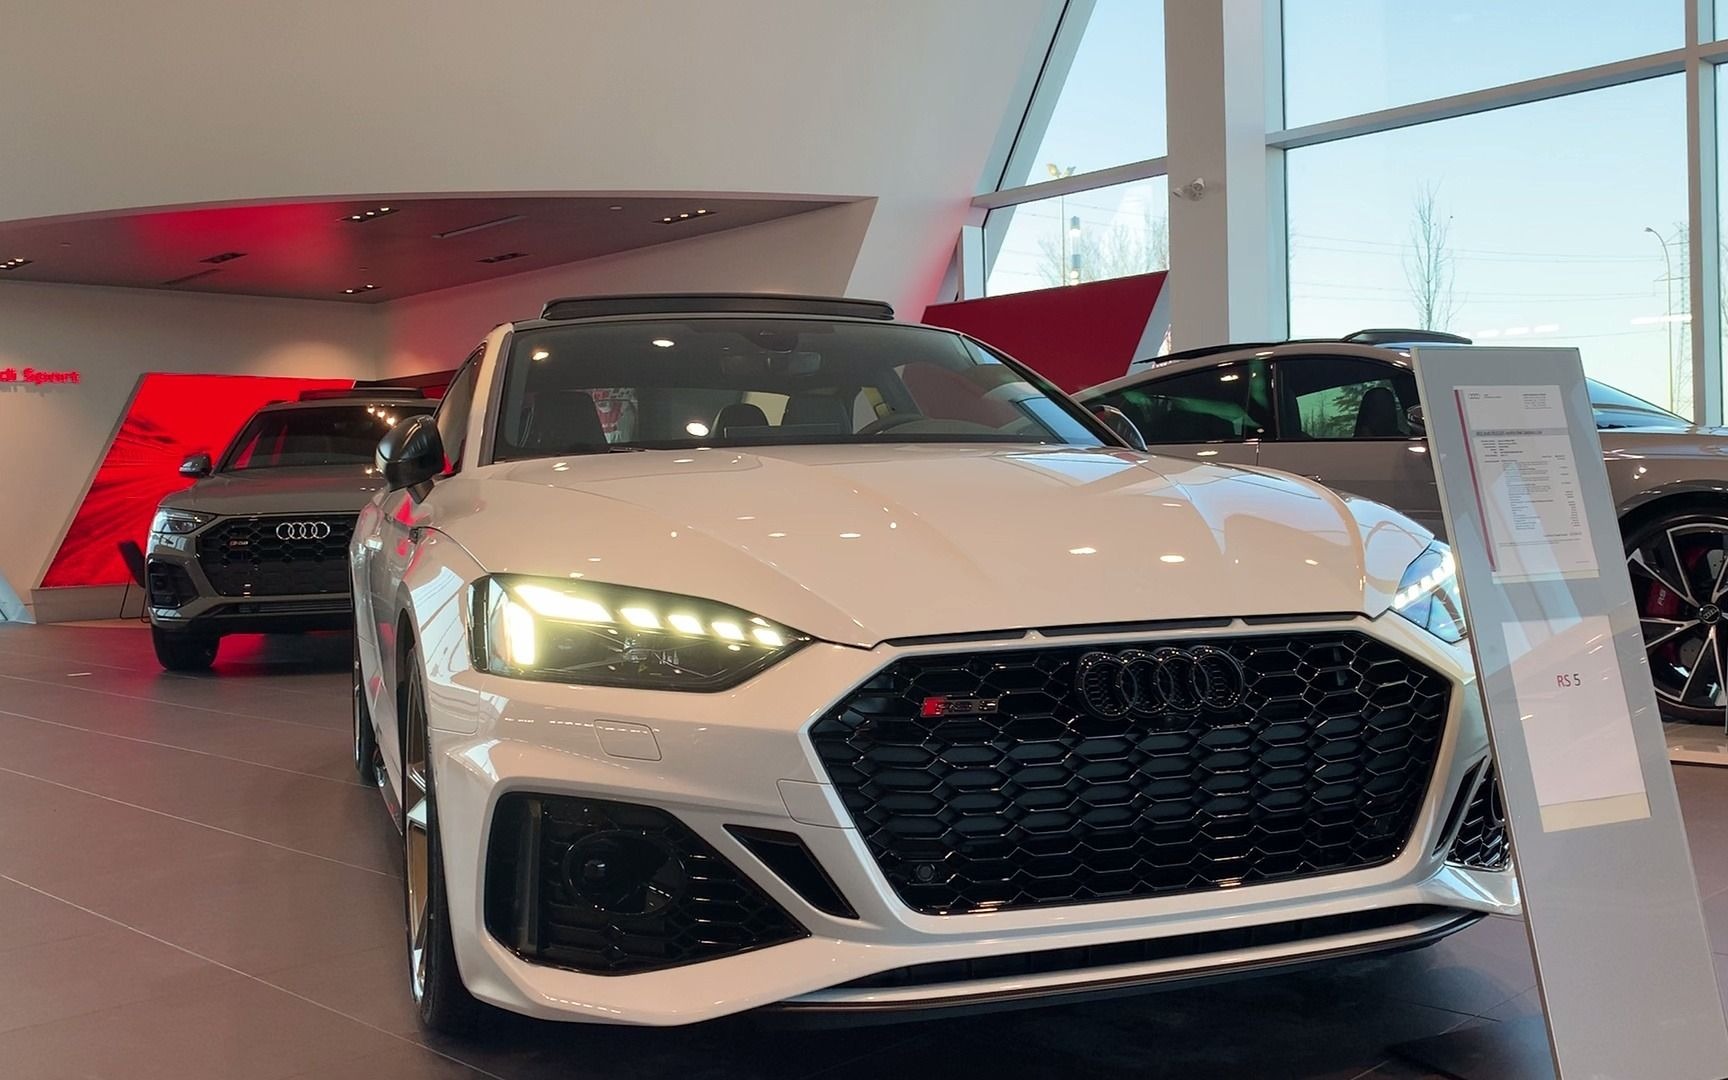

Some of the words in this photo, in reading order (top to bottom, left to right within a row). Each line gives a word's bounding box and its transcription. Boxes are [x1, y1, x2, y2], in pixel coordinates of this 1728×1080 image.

[23, 368, 80, 385] Sport
[1556, 674, 1571, 687] RS
[1573, 673, 1581, 686] 5
